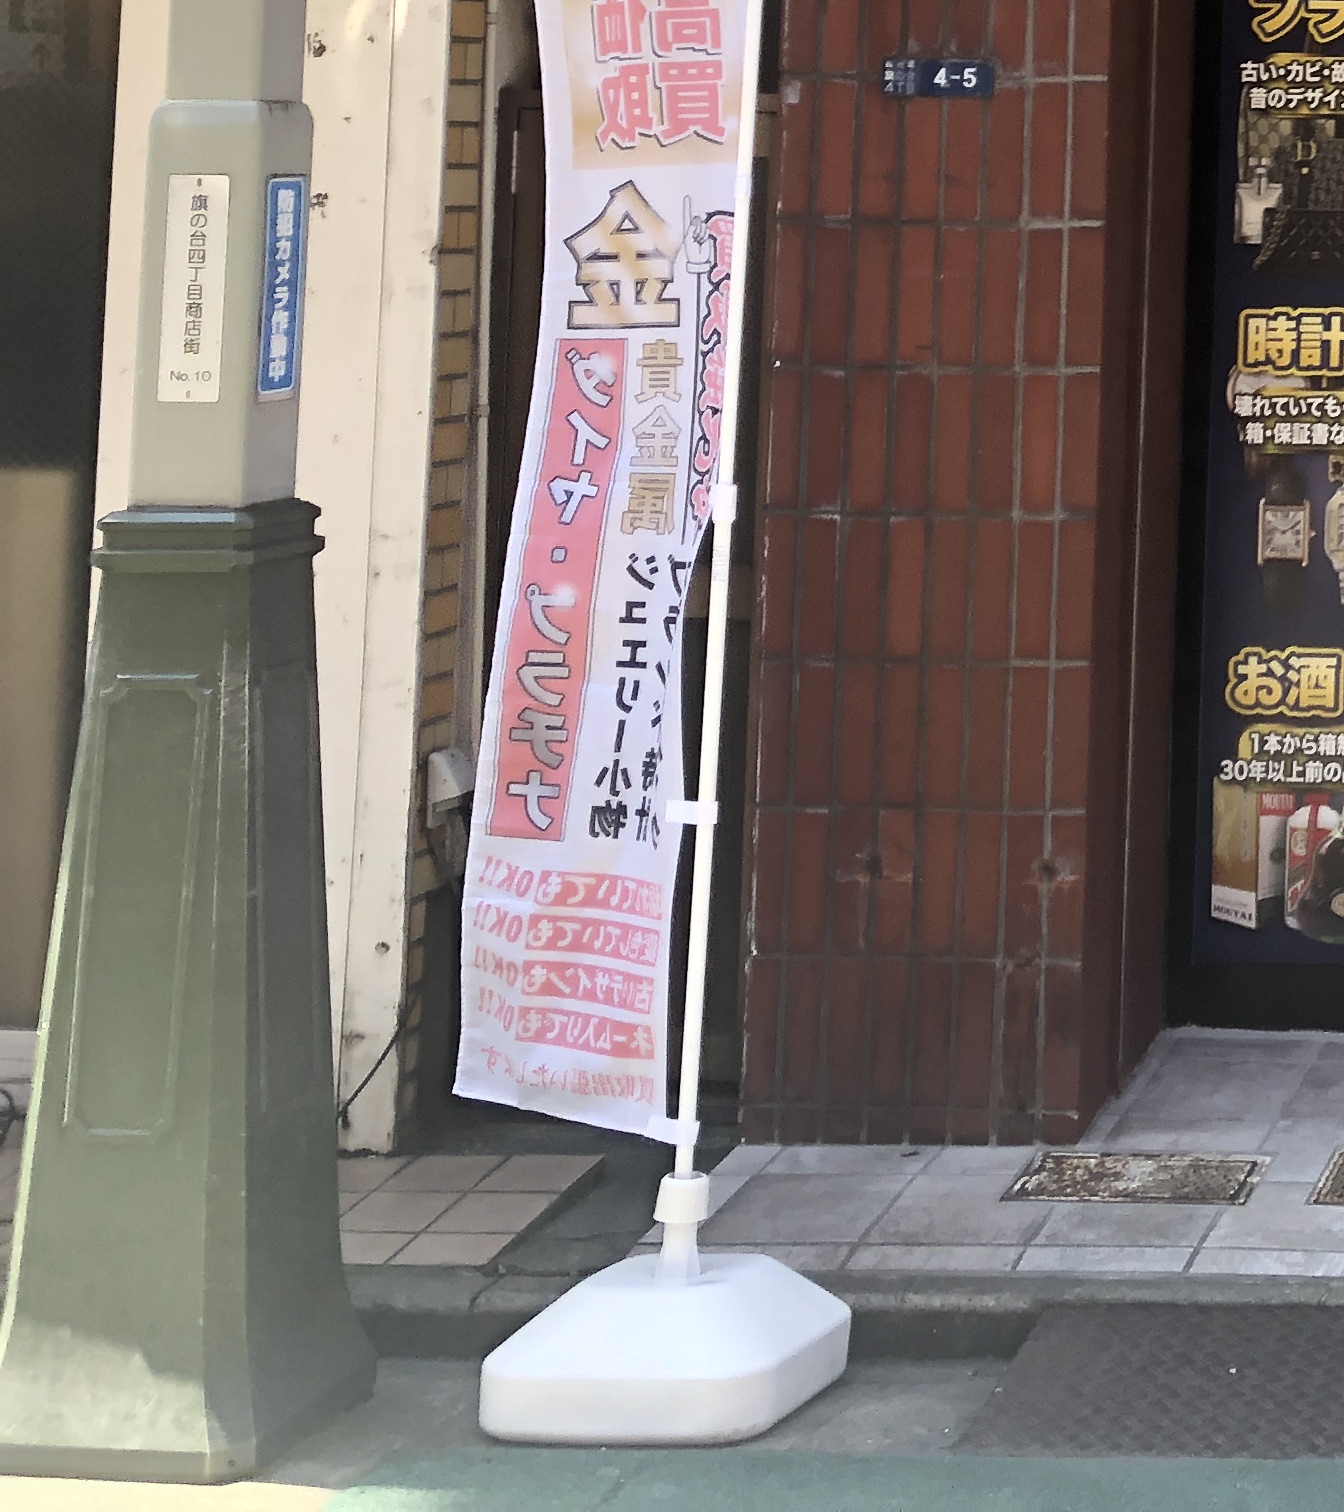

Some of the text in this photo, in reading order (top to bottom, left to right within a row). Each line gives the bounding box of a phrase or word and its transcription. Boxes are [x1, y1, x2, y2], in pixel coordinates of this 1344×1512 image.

[933, 67, 978, 88] 4-5
[183, 193, 209, 356] 旗の台四丁目商店街
[1230, 649, 1343, 715] お酒
